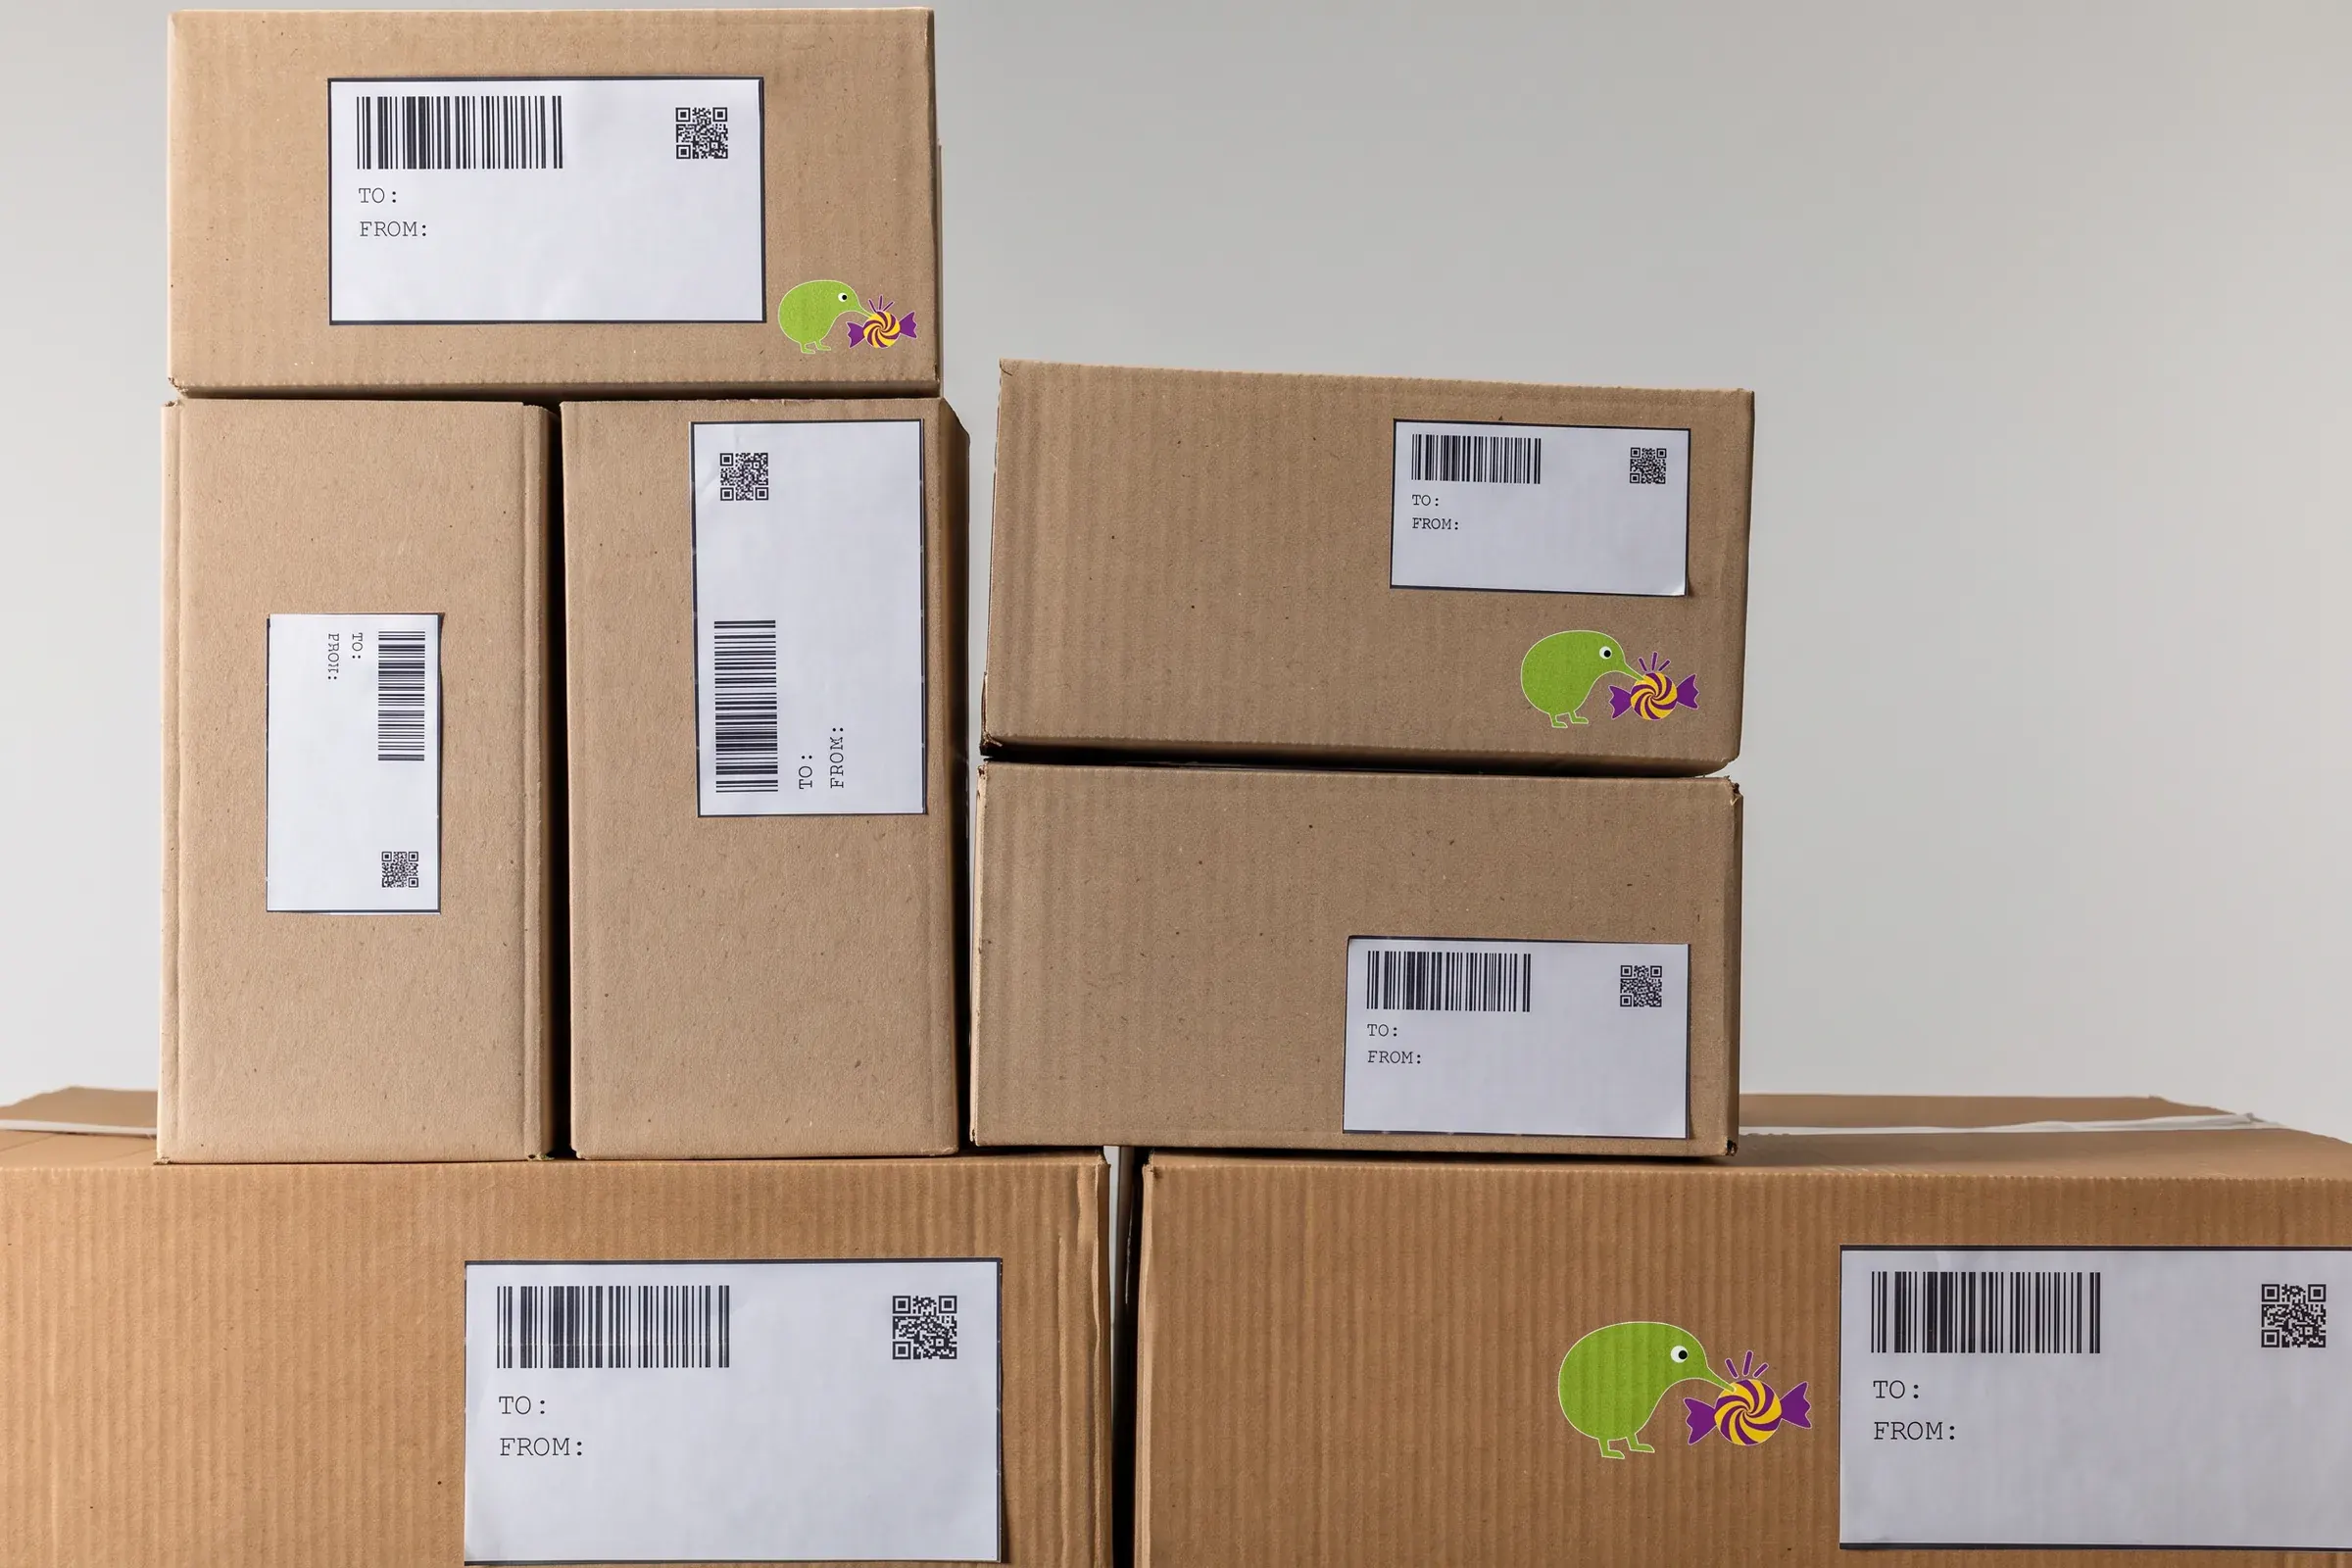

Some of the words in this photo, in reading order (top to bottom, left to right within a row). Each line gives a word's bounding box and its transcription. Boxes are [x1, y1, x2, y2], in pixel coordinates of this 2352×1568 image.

[359, 188, 396, 203] TO:
[360, 221, 426, 236] FROM:
[1412, 495, 1440, 507] TO:
[1412, 517, 1458, 530] FROM:
[352, 632, 364, 659] TO:
[830, 727, 844, 788] FROM:
[799, 756, 812, 789] TO:
[1367, 1024, 1397, 1037] TO:
[1368, 1051, 1420, 1064] FROM:
[1873, 1380, 1919, 1398] TO:
[499, 1396, 545, 1414] TO:
[1874, 1421, 1954, 1440] FROM:
[500, 1438, 582, 1456] FROM:
